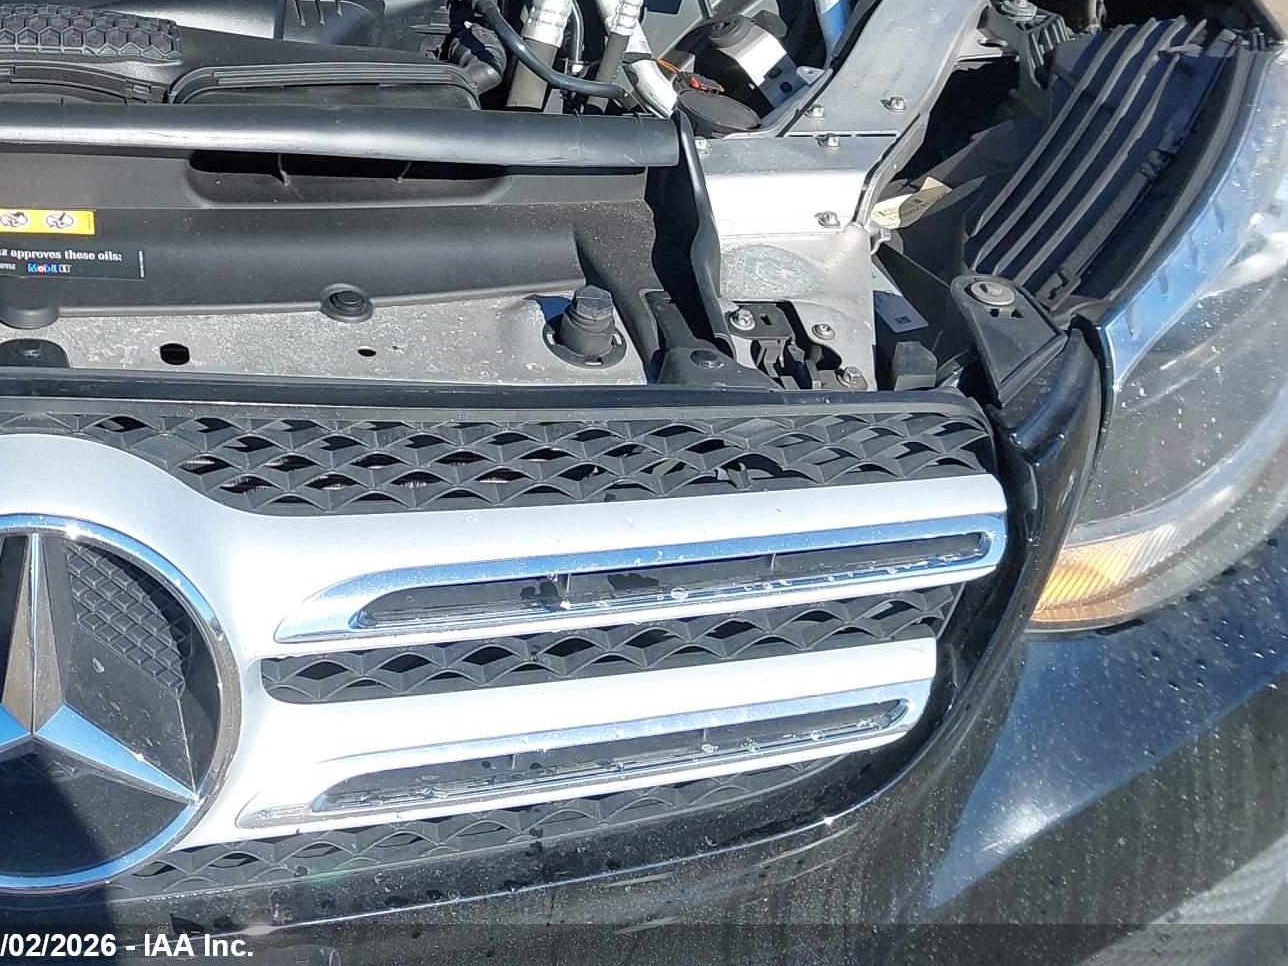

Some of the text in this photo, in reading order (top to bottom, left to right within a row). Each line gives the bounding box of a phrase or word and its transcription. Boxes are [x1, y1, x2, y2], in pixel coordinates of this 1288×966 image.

[10, 248, 62, 260] approves
[64, 249, 96, 260] these
[97, 250, 122, 262] oils:
